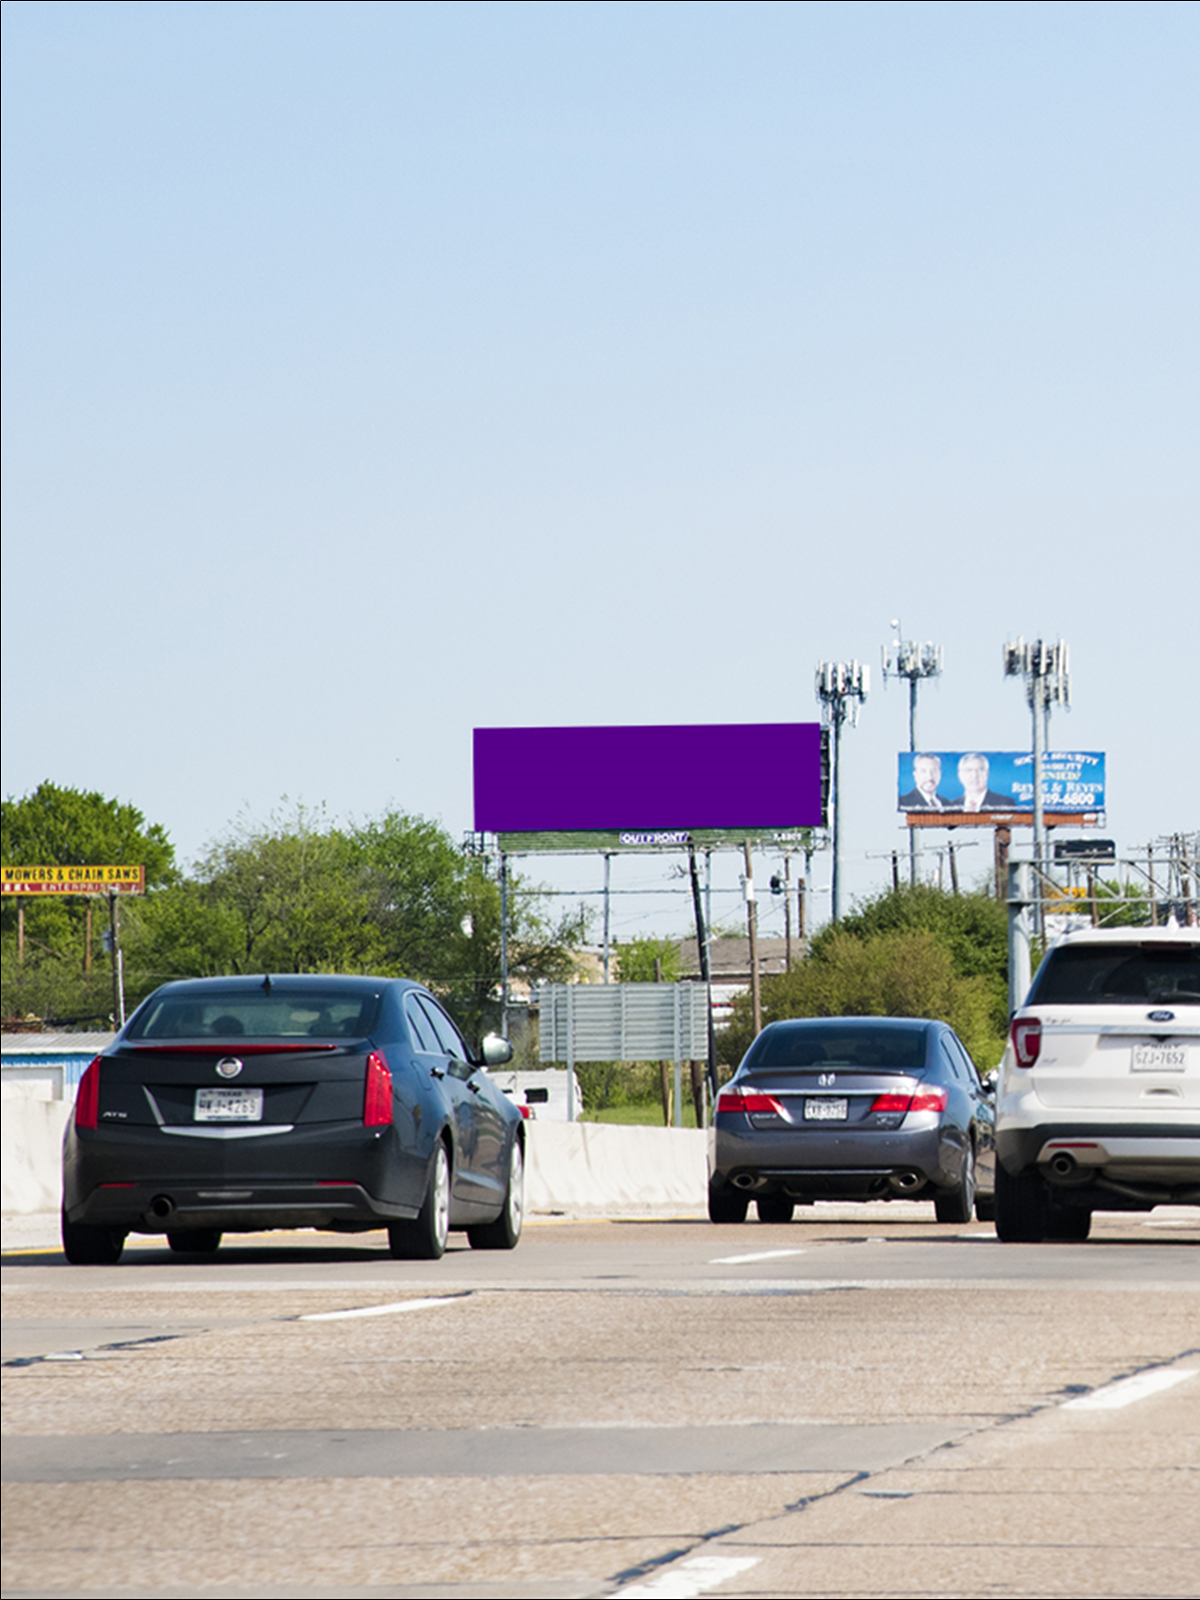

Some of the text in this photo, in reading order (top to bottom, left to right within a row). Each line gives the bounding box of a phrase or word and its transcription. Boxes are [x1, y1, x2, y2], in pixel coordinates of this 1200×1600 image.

[4, 868, 54, 881] MOWERS
[68, 868, 104, 881] CHAIN
[107, 868, 139, 881] SAWS
